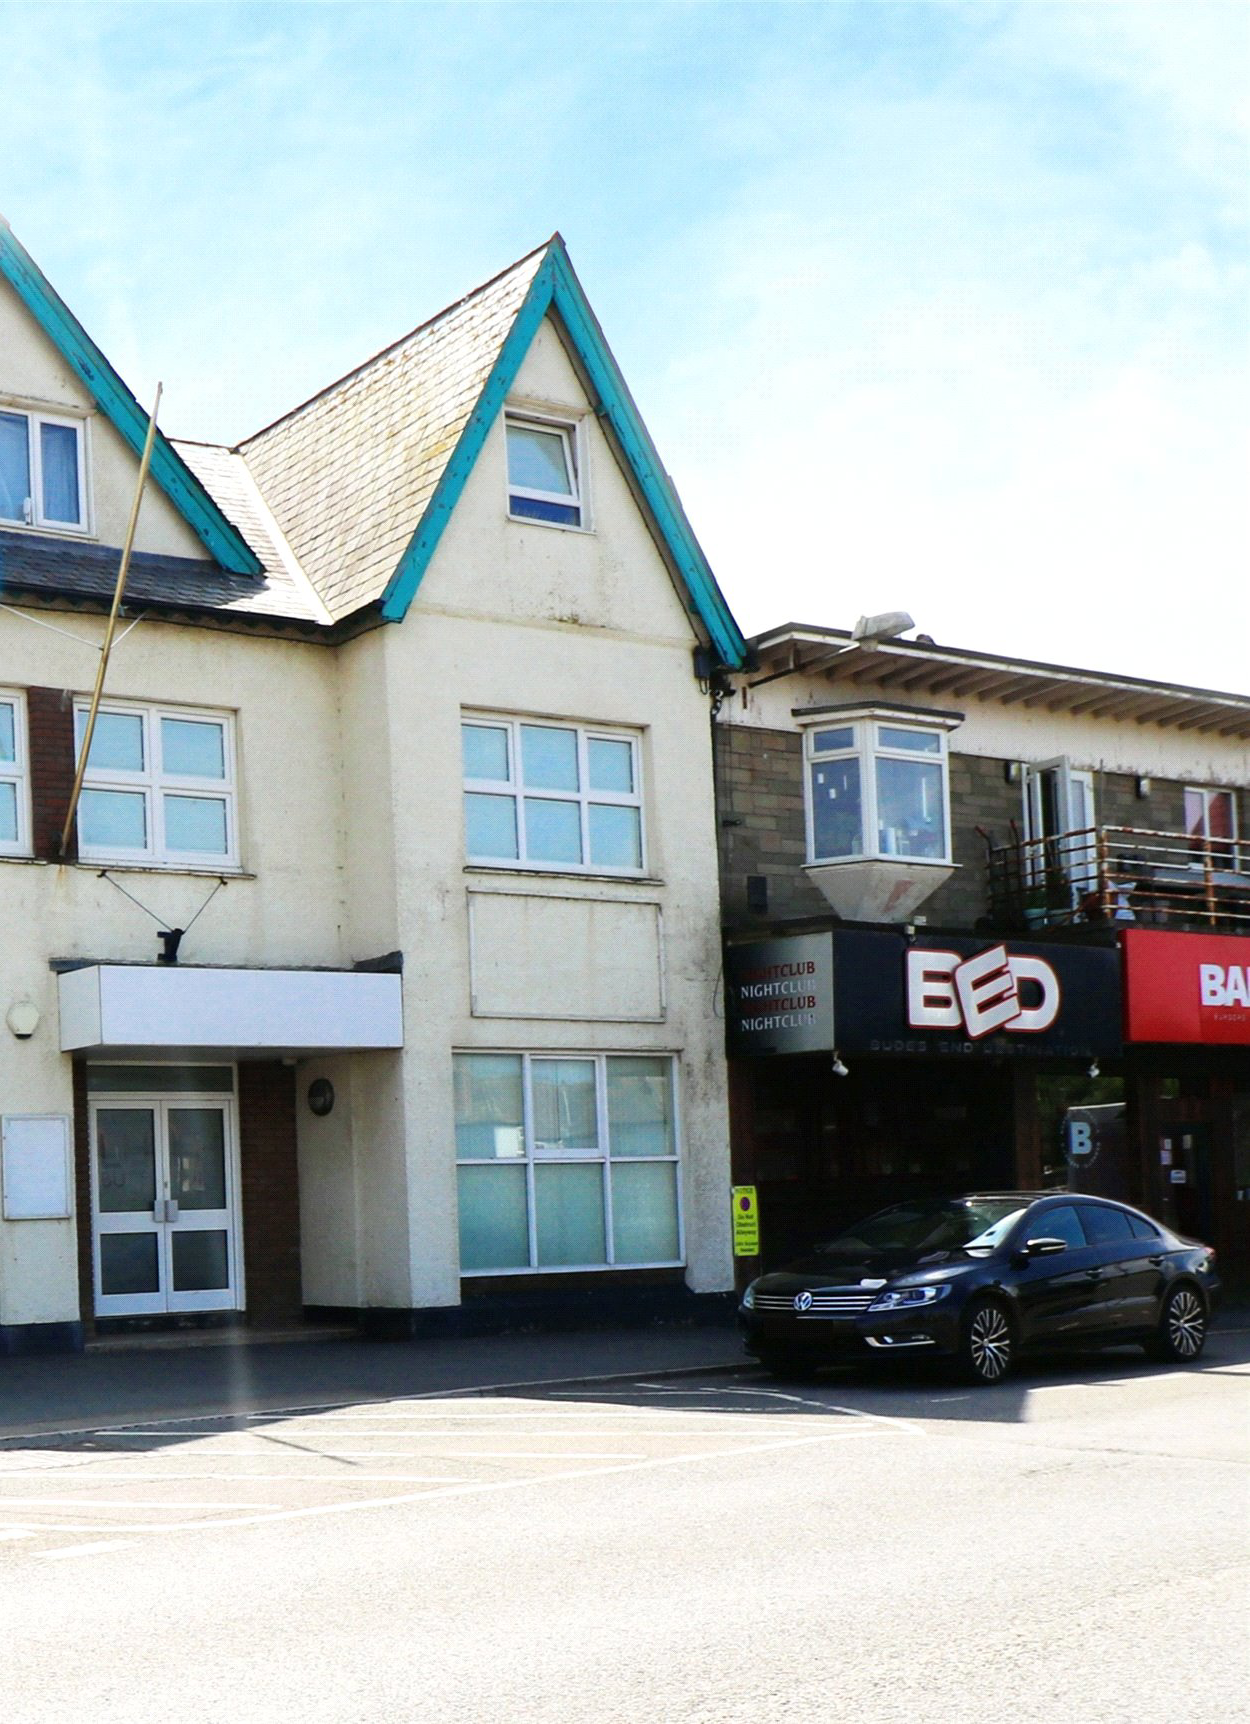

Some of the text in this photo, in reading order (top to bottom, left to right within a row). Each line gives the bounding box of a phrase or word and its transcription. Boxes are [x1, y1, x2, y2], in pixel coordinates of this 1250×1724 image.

[741, 979, 817, 999] NIGHTCLUB
[906, 944, 1061, 1040] BED
[1199, 963, 1250, 1007] BA
[742, 995, 817, 1016] HTCLUB
[741, 1013, 817, 1032] NIGHTCLUB
[1069, 1121, 1093, 1155] B
